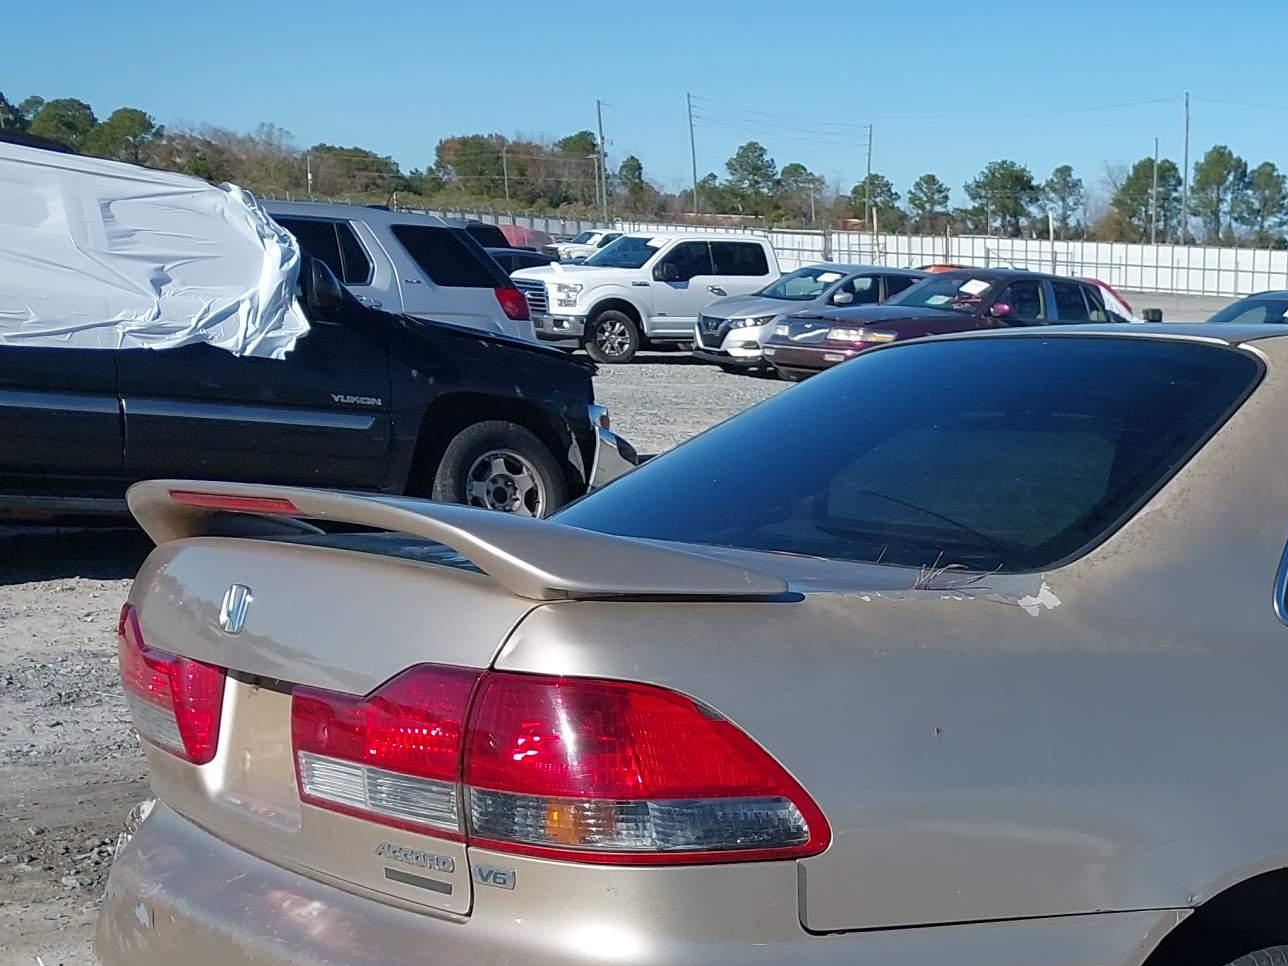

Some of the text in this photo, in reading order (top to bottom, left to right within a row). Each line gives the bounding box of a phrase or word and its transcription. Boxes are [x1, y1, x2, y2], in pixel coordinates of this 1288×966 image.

[330, 393, 382, 406] YUKON
[376, 840, 456, 873] ACCORD
[477, 866, 509, 887] V6
